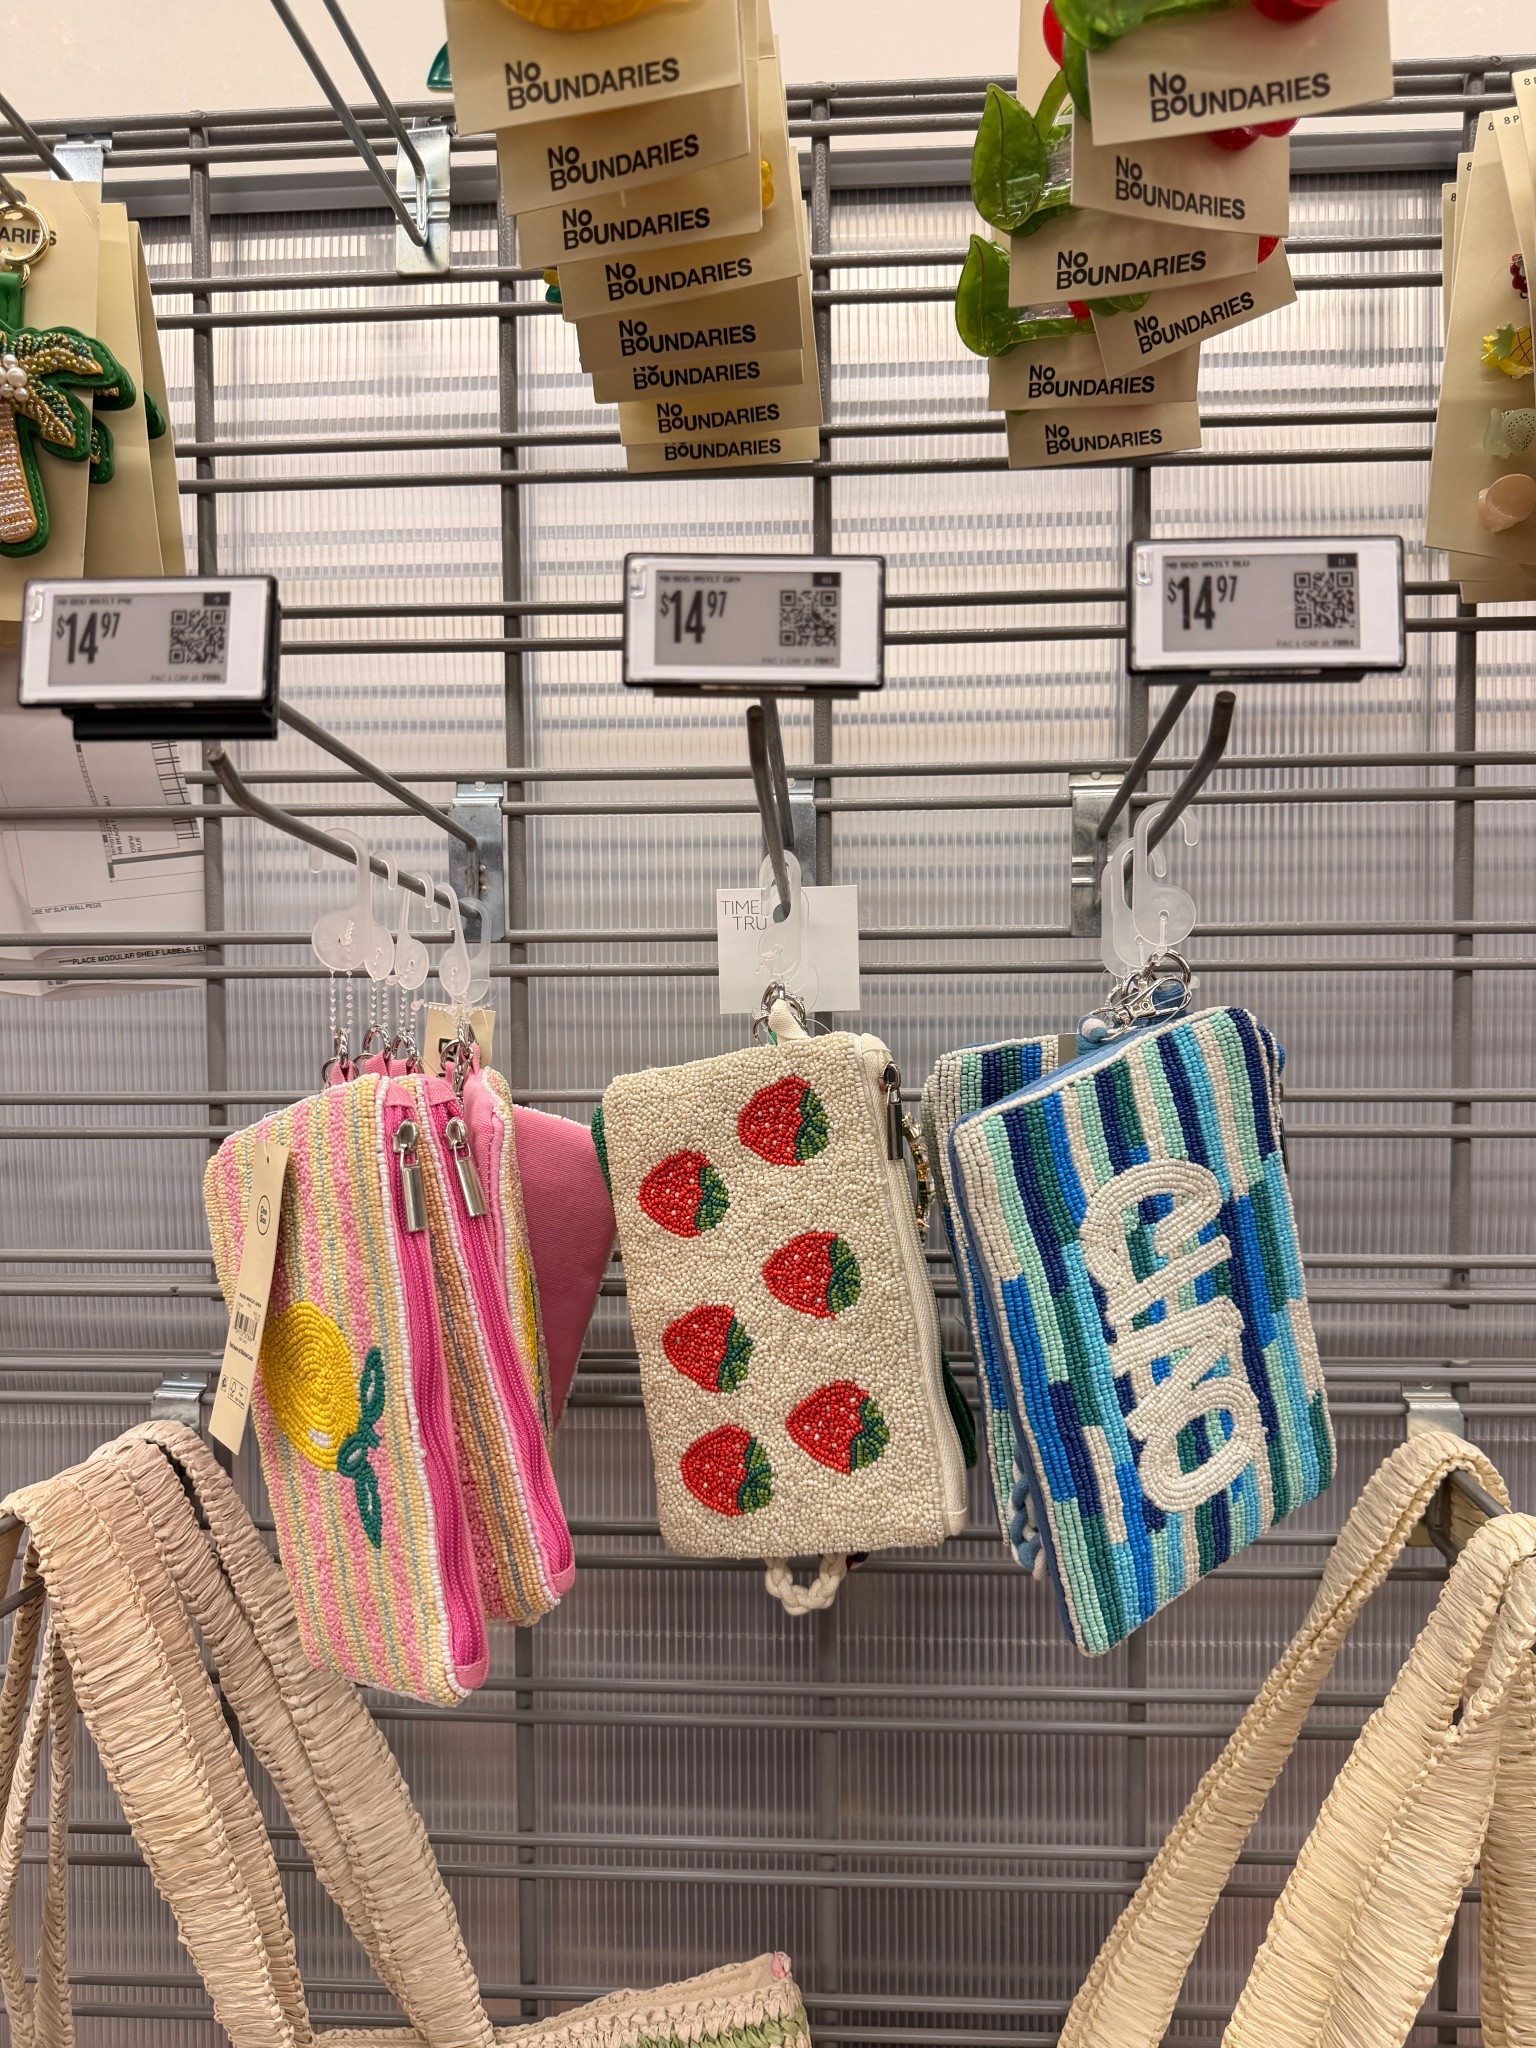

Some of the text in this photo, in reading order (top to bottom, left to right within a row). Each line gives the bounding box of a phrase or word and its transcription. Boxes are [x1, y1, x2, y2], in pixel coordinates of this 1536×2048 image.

[507, 57, 680, 111] BOUNDARIES
[1151, 72, 1332, 123] BOUNDARIES
[550, 134, 700, 192] BOUNDARIES
[1115, 178, 1246, 220] BOUNDARIES
[563, 207, 711, 250] BOUNDARIES
[607, 257, 752, 302] BOUNDARIES
[1056, 250, 1206, 290] BOUNDARIES
[620, 324, 757, 357] BOUNDARIES
[1137, 291, 1255, 355] BOUNDARIES
[633, 361, 761, 390] BOUNDARIES
[1028, 375, 1155, 398] BOUNDARIES
[657, 403, 780, 434] BOUNDARIES
[664, 438, 781, 461] BOUNDARIES
[1046, 428, 1163, 456] BOUNDARIES
[720, 900, 759, 915] TIME
[98, 952, 135, 962] MODULAR
[136, 949, 160, 958] SHELF
[162, 946, 191, 955] LABELS
[1080, 1158, 1262, 1512] CIAO
